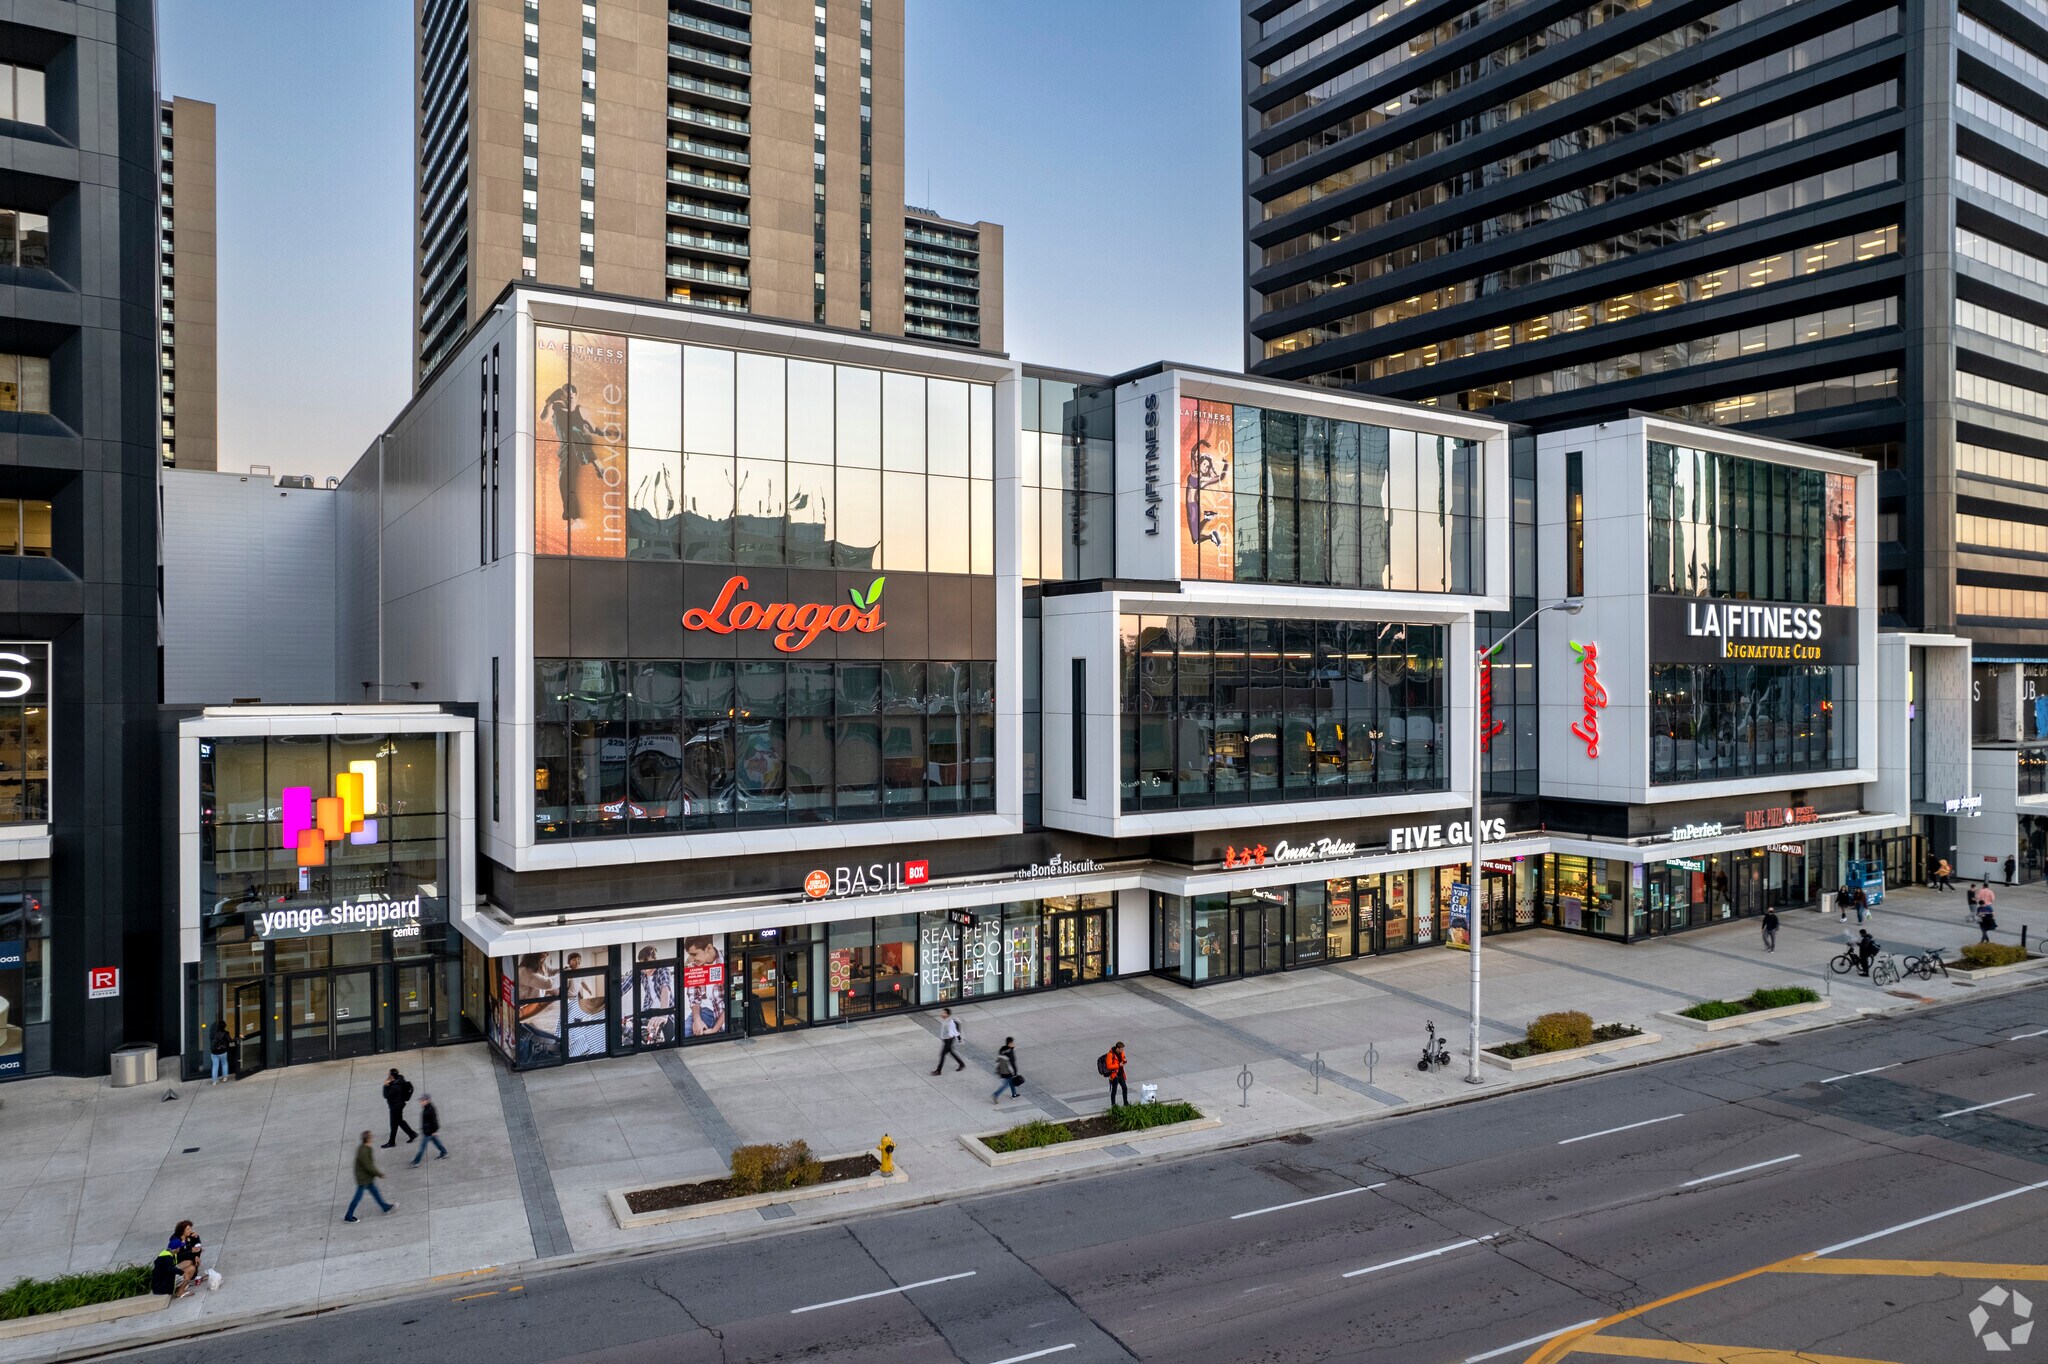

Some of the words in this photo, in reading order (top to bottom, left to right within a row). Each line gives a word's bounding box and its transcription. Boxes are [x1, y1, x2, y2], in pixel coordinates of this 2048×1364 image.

[539, 341, 556, 350] LA
[563, 343, 624, 359] FITNESS
[1193, 410, 1231, 422] FITNESS
[1145, 393, 1160, 498] FITNESS
[597, 383, 623, 543] innovate
[1686, 602, 1722, 637] LA
[1727, 605, 1822, 640] FITNESS
[1745, 810, 1765, 830] BLAZE
[1767, 807, 1782, 828] PIZZA
[1390, 824, 1441, 852] FIVE
[1448, 818, 1506, 845] GUYS
[1672, 822, 1723, 842] imPerfect
[1274, 840, 1316, 862] Omni
[1317, 837, 1357, 860] Palace
[909, 866, 924, 879] BOX
[1494, 862, 1512, 871] GUYS
[835, 861, 910, 896] BASIL
[261, 911, 323, 937] yonge
[330, 894, 420, 927] sheppard
[392, 927, 419, 938] centre
[761, 929, 776, 938] open
[921, 925, 959, 945] REAL
[1387, 928, 1401, 936] GUYS
[921, 945, 960, 966] REAL
[96, 972, 113, 987] R
[922, 965, 960, 986] REAL
